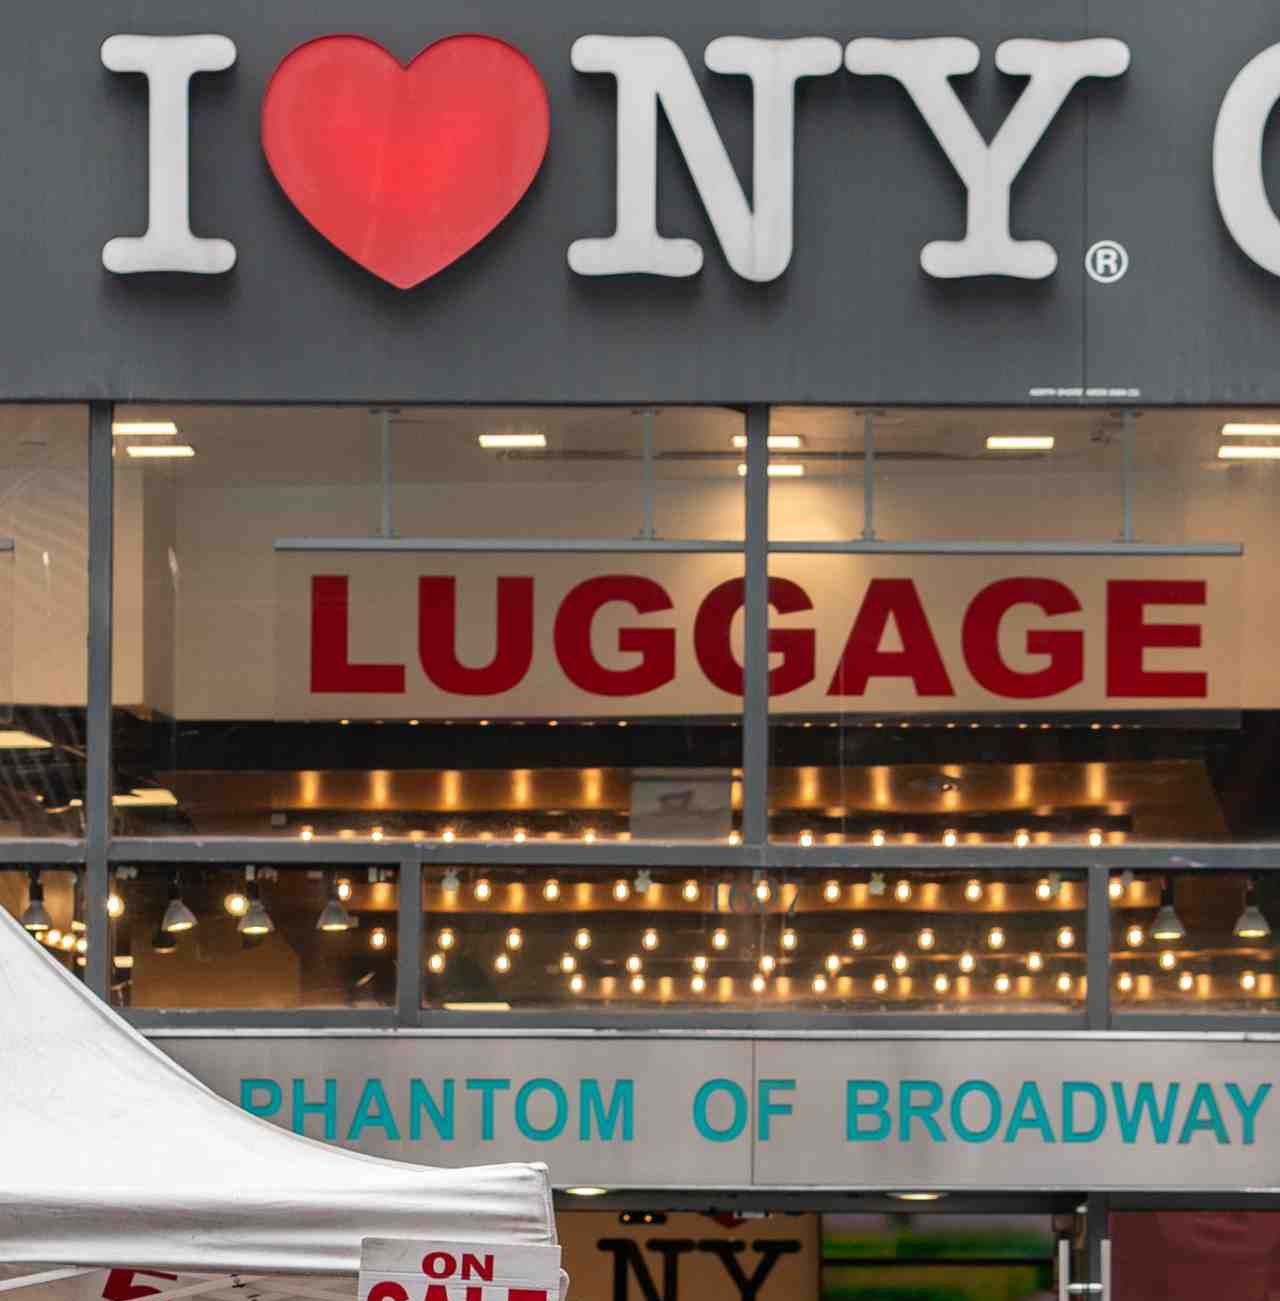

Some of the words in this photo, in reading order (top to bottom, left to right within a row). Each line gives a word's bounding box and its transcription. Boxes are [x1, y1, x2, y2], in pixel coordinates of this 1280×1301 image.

[101, 34, 237, 273] I
[567, 34, 1130, 282] NY
[309, 575, 1208, 699] LUGGAGE
[240, 1077, 636, 1142] PHANTOM
[692, 1077, 798, 1143] OF
[844, 1079, 1274, 1146] BROADWAY
[421, 1251, 495, 1282] ON
